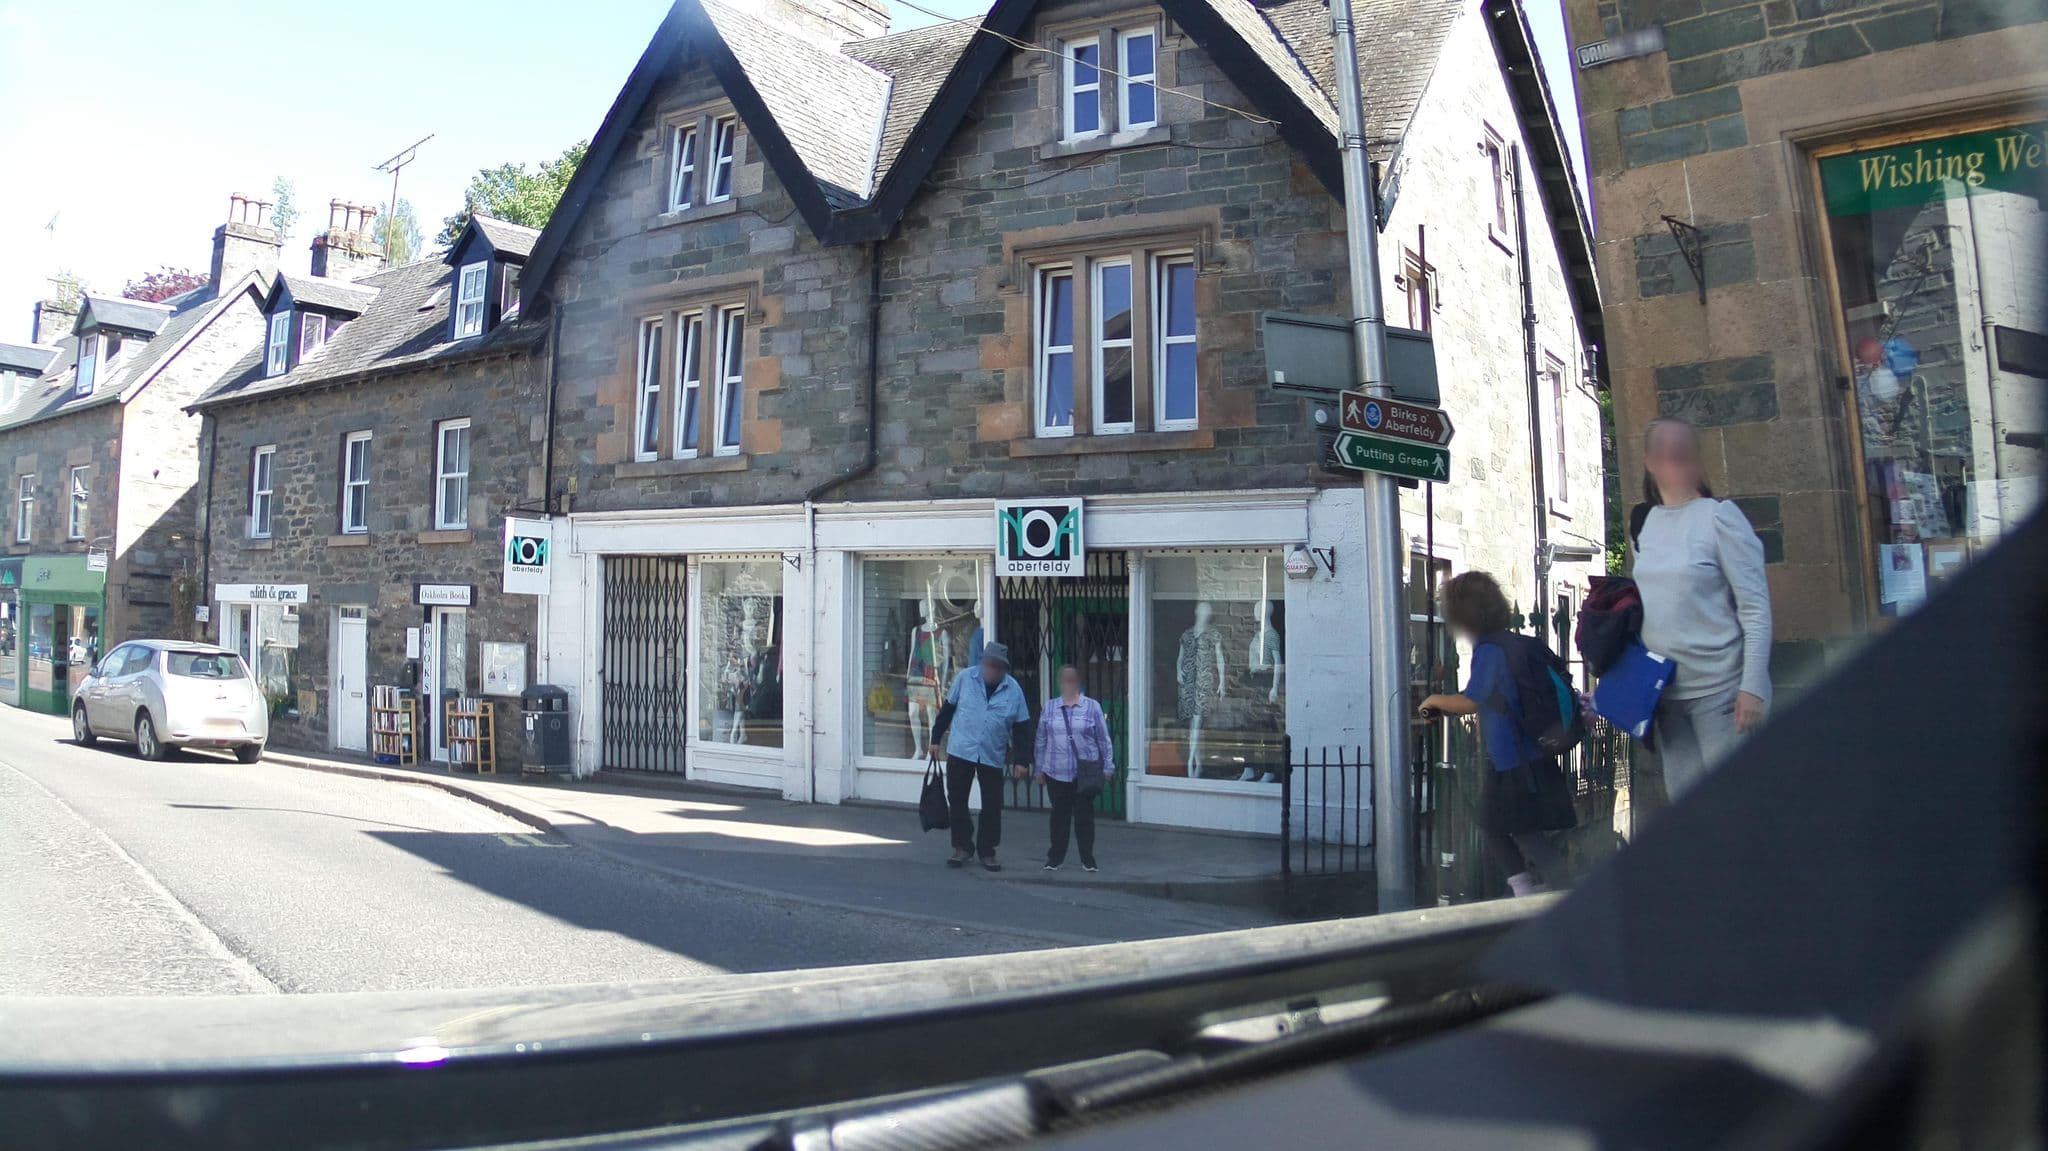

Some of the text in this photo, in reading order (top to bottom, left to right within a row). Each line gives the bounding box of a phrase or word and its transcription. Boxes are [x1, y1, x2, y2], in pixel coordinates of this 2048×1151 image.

[1859, 149, 1985, 192] Wishing
[1391, 407, 1418, 422] Birks
[1385, 420, 1436, 439] Aberfeldy
[1356, 446, 1429, 467] Putting Green
[999, 506, 1079, 557] NOA
[508, 535, 548, 565] NOA
[512, 566, 544, 574] aberfeldy
[1008, 560, 1070, 573] aberfeldy
[250, 585, 298, 601] edith & grace
